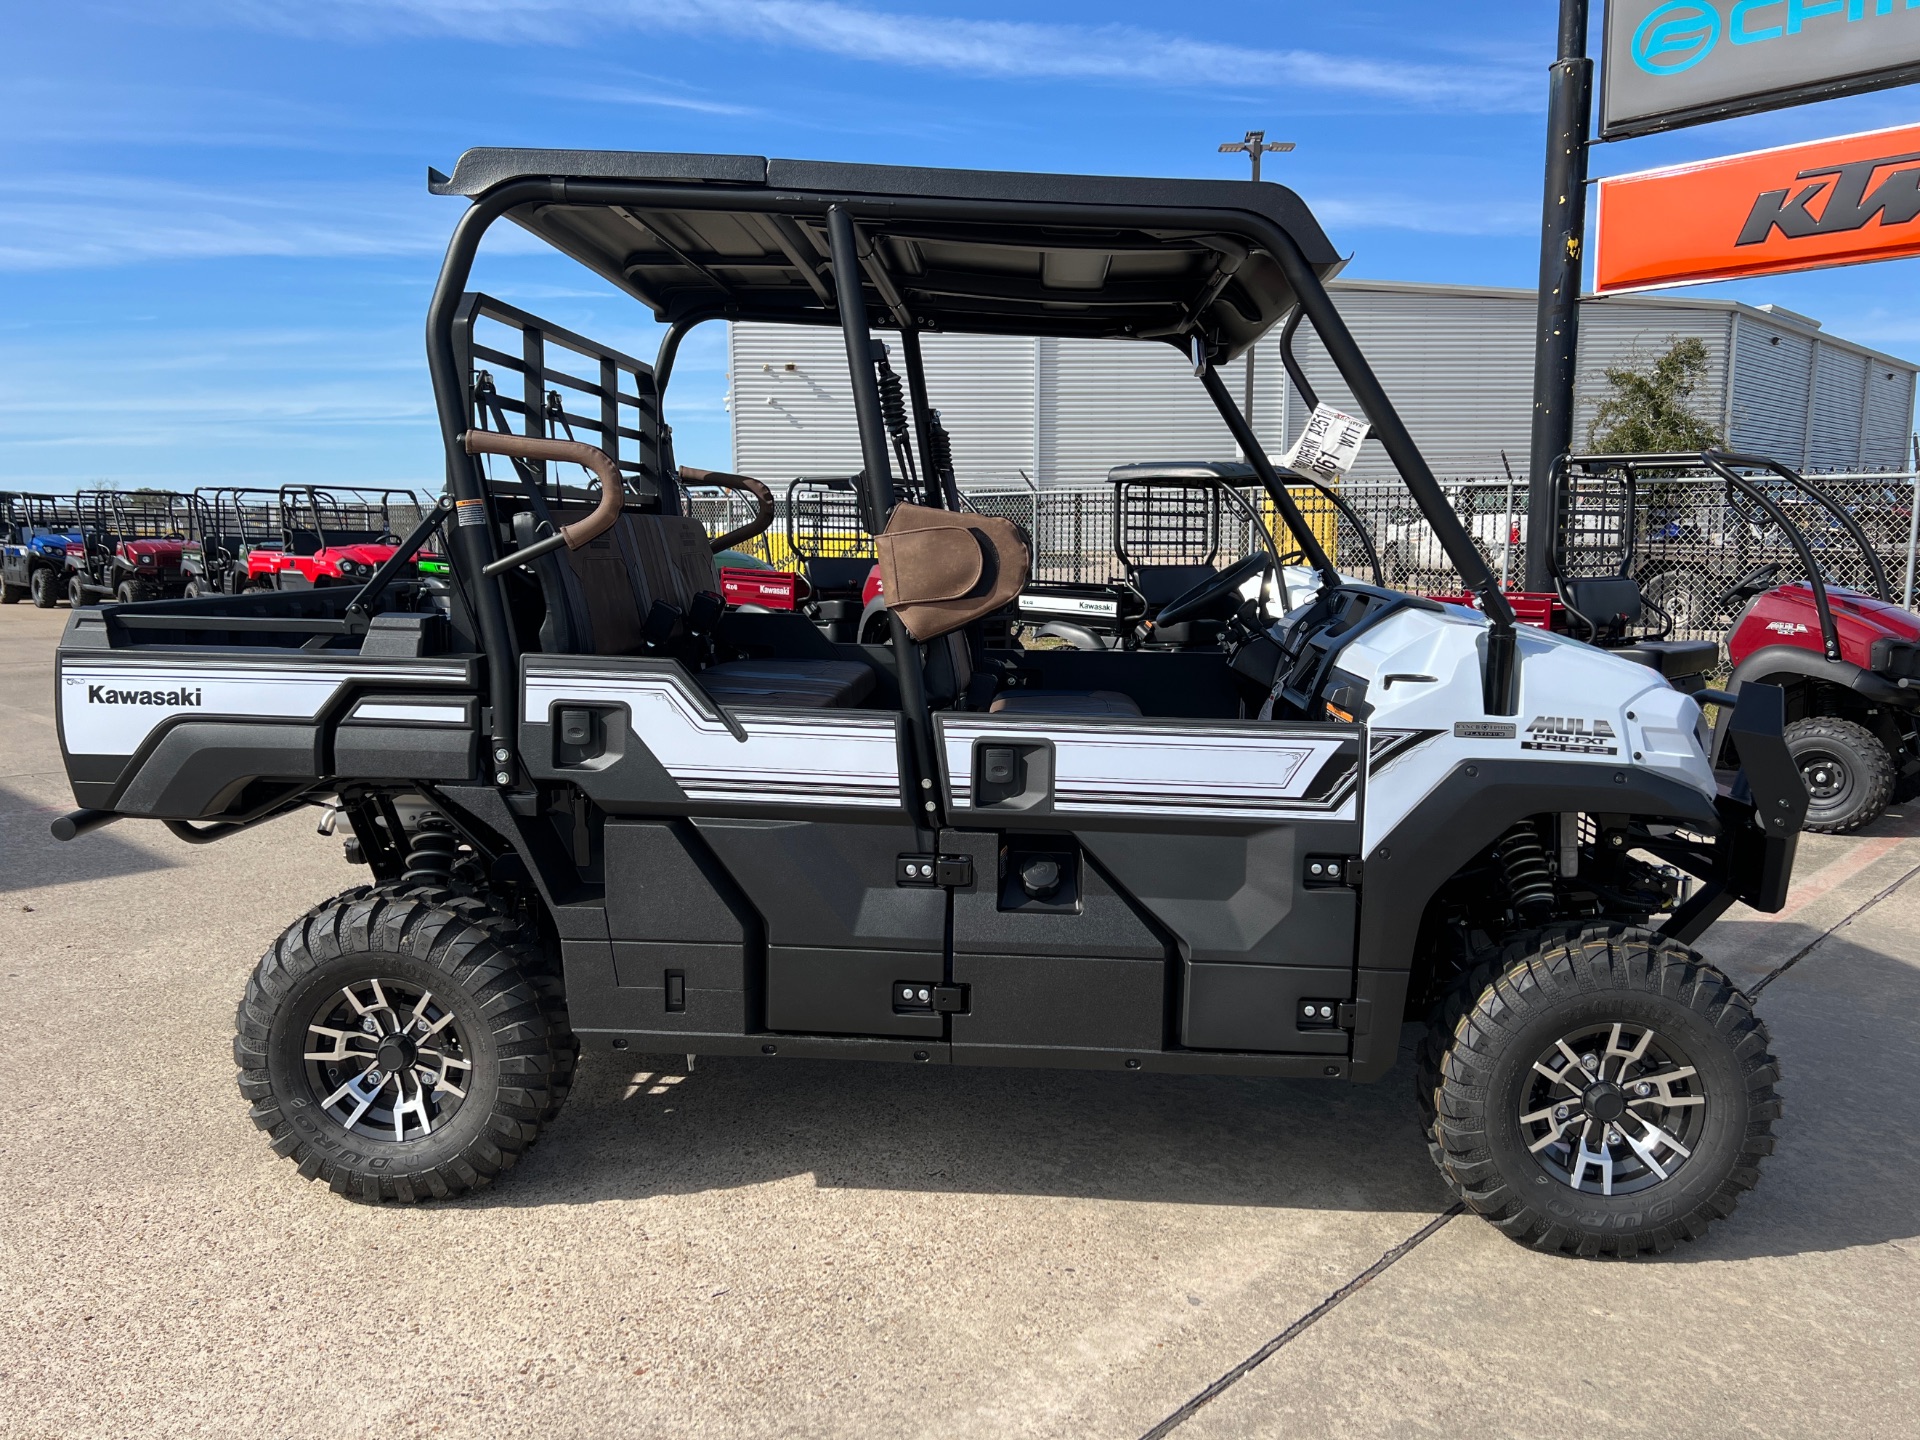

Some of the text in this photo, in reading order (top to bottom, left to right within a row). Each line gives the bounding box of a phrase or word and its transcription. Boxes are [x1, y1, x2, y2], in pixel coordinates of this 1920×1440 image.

[1308, 413, 1332, 438] A251
[760, 585, 790, 595] Kawasaki
[1079, 601, 1113, 611] Kawasaki
[1765, 621, 1809, 633] MULE
[88, 684, 202, 706] Kawasaki
[1525, 716, 1616, 738] MULE
[1533, 734, 1608, 745] PRO-FXT
[294, 1114, 394, 1170] DURO
[1546, 1196, 1675, 1229] DURO
